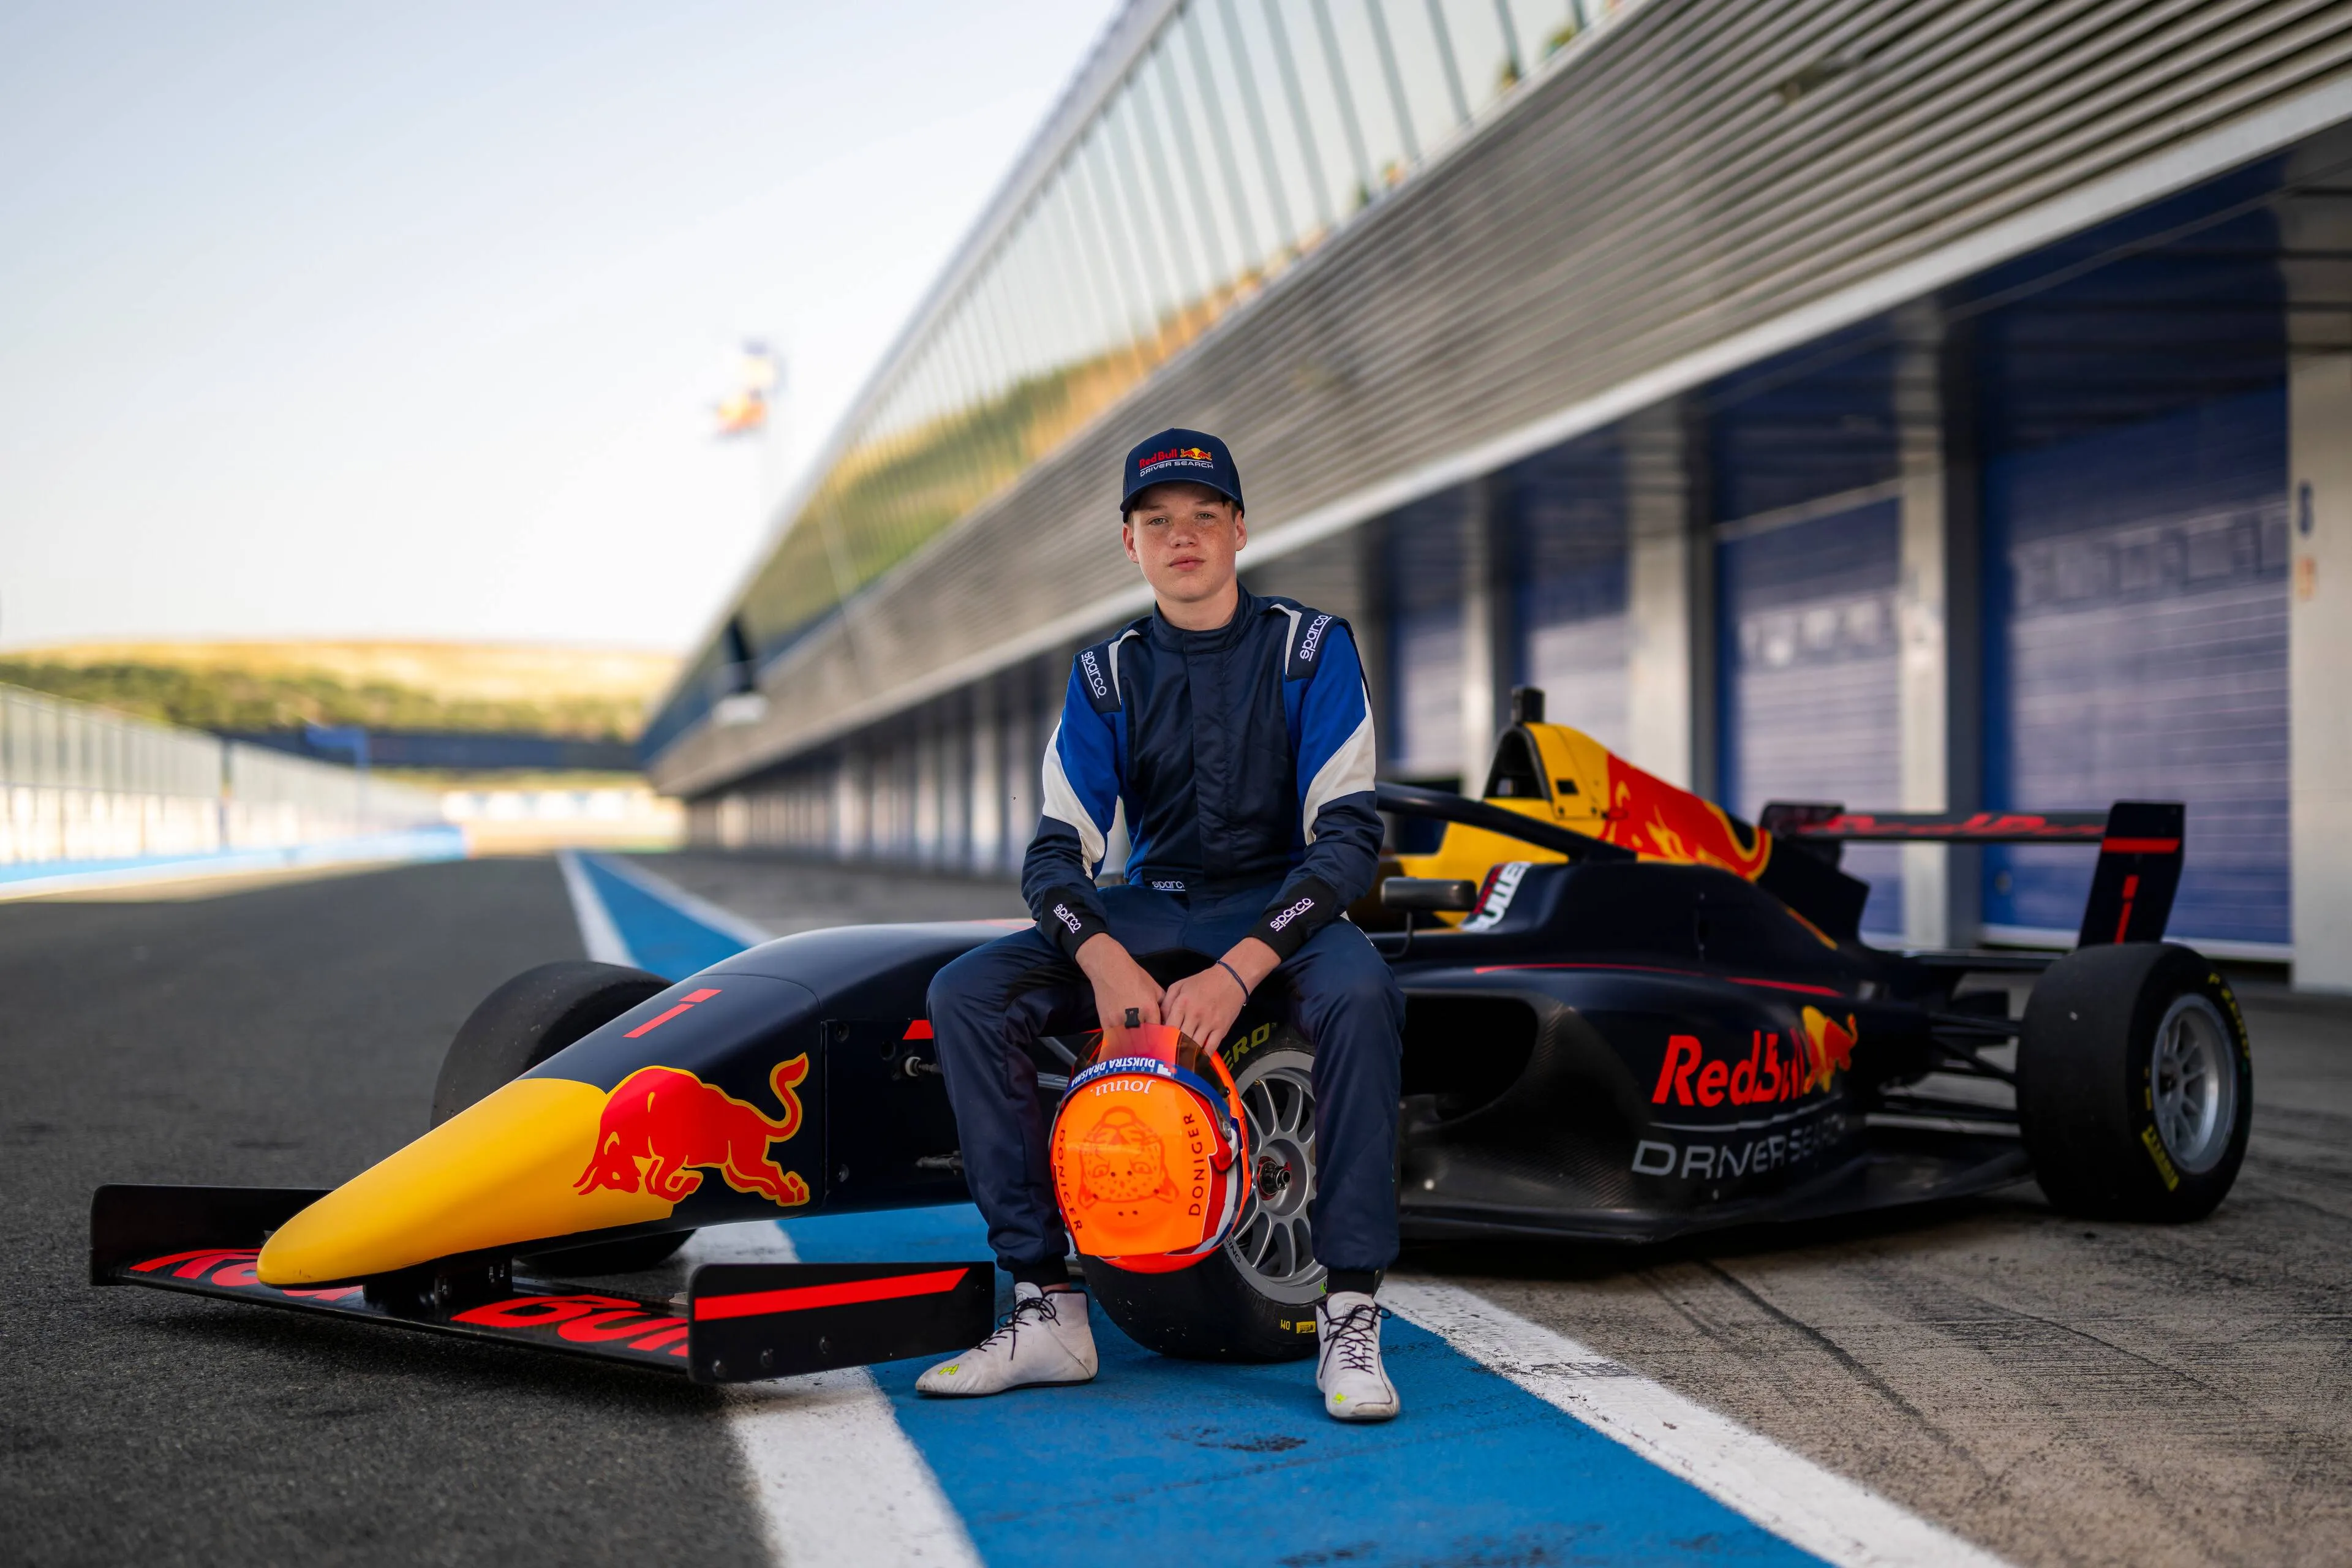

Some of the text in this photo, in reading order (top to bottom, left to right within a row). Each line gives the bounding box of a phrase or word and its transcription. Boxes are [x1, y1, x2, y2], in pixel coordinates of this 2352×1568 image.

[1140, 461, 1213, 477] DRIVER SEARCH
[1300, 615, 1331, 661] sparco
[1081, 651, 1107, 698] sparco
[1270, 898, 1314, 931] sparco
[1071, 1057, 1155, 1087] DIJKSTRA DRAISMA
[1058, 1129, 1082, 1231] DONIGER
[1183, 1113, 1205, 1216] DONIGER
